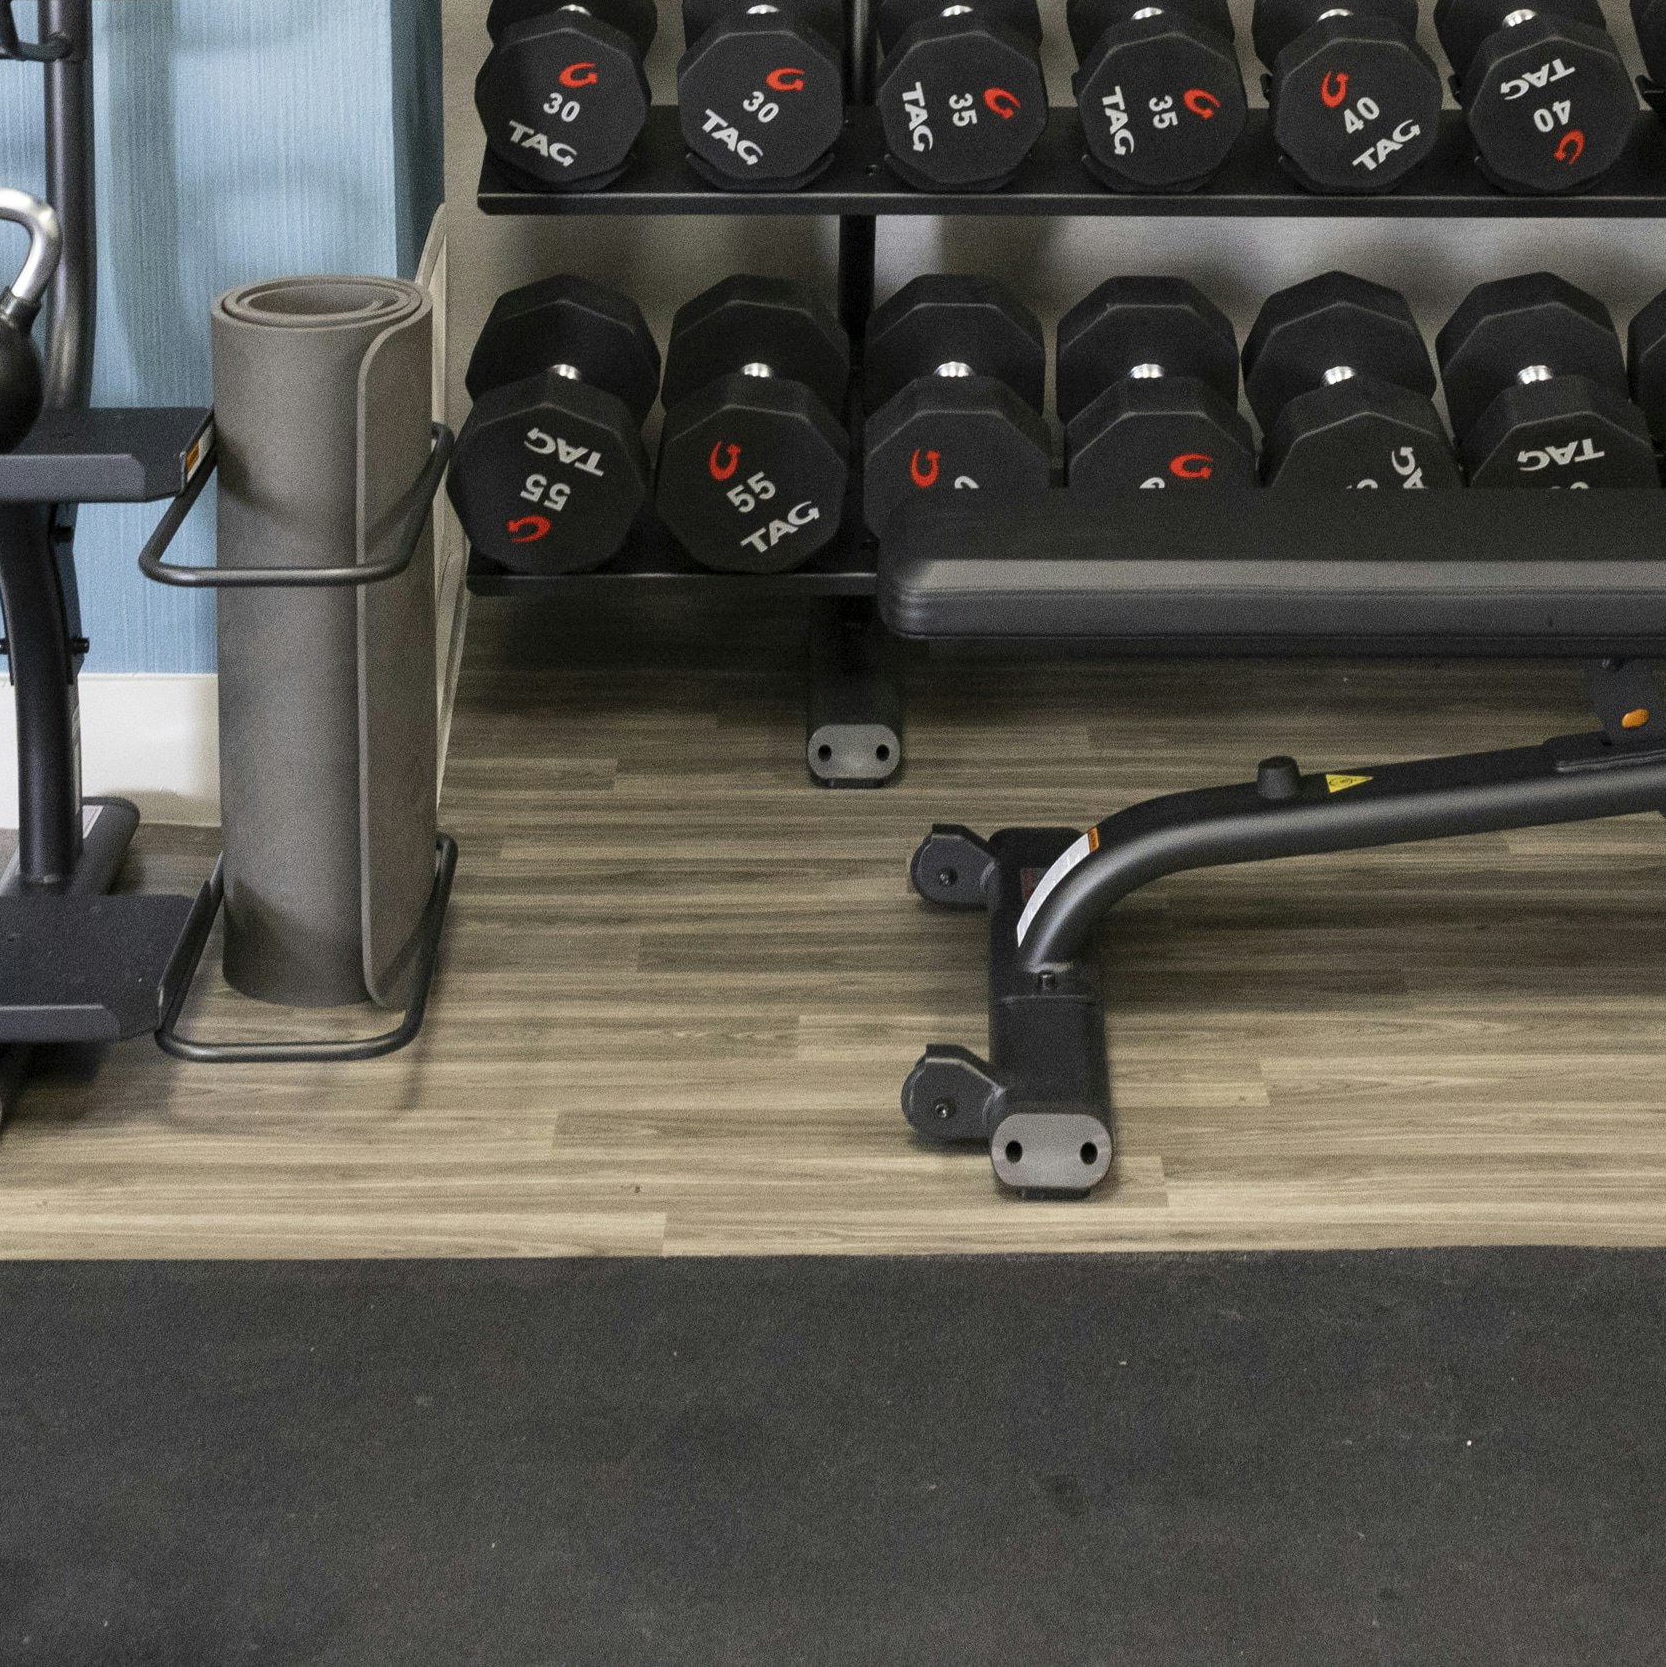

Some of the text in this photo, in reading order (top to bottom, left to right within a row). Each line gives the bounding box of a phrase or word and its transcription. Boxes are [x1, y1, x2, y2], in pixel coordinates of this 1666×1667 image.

[1500, 58, 1576, 100] TAG
[542, 92, 581, 123] 30
[742, 90, 780, 124] 30
[901, 81, 934, 152] TAG
[948, 92, 978, 127] 35
[1101, 85, 1135, 156] TAG
[1148, 95, 1179, 129] 35
[1343, 96, 1380, 134] 40
[1533, 99, 1571, 133] 40
[509, 117, 578, 167] TAG
[701, 107, 766, 166] TAG
[1349, 117, 1421, 171] TAG
[524, 427, 604, 479] TAG
[1391, 446, 1424, 489] AG
[1517, 438, 1605, 471] TAG
[520, 474, 571, 511] 55
[726, 471, 776, 513] 55
[738, 499, 820, 553] TAG
